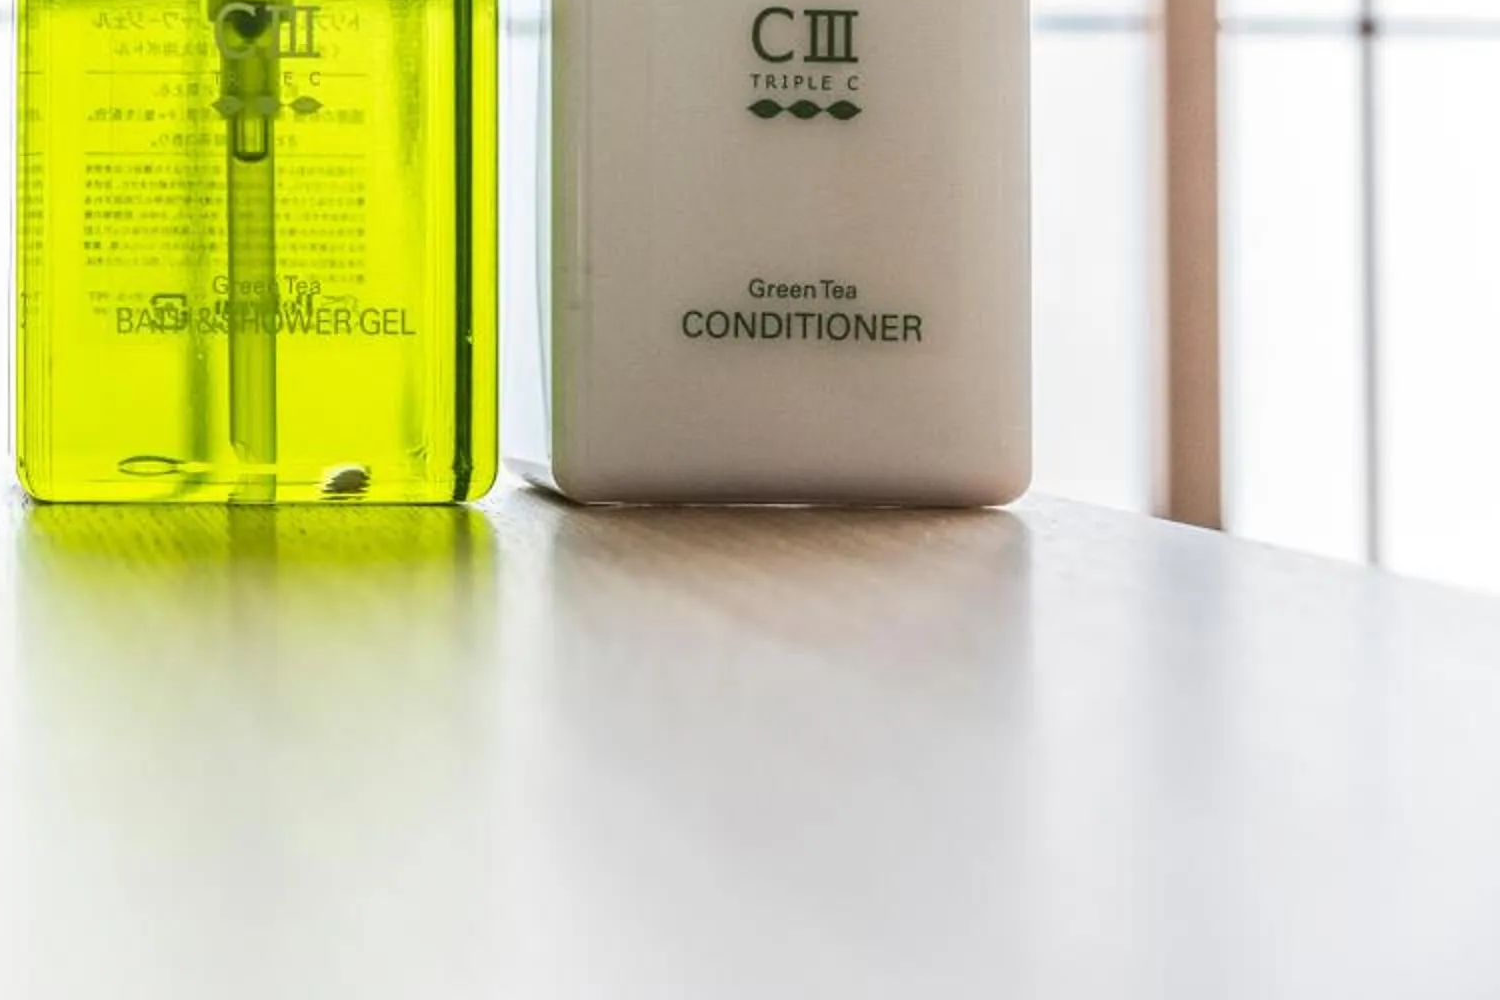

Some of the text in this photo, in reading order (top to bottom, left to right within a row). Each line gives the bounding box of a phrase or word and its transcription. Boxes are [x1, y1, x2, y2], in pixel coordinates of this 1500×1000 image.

[749, 73, 860, 91] TRIPLE C
[212, 275, 322, 296] Green Tea
[748, 278, 857, 300] Green Tea
[359, 308, 417, 336] GEL
[681, 310, 924, 343] CONDITIONER
